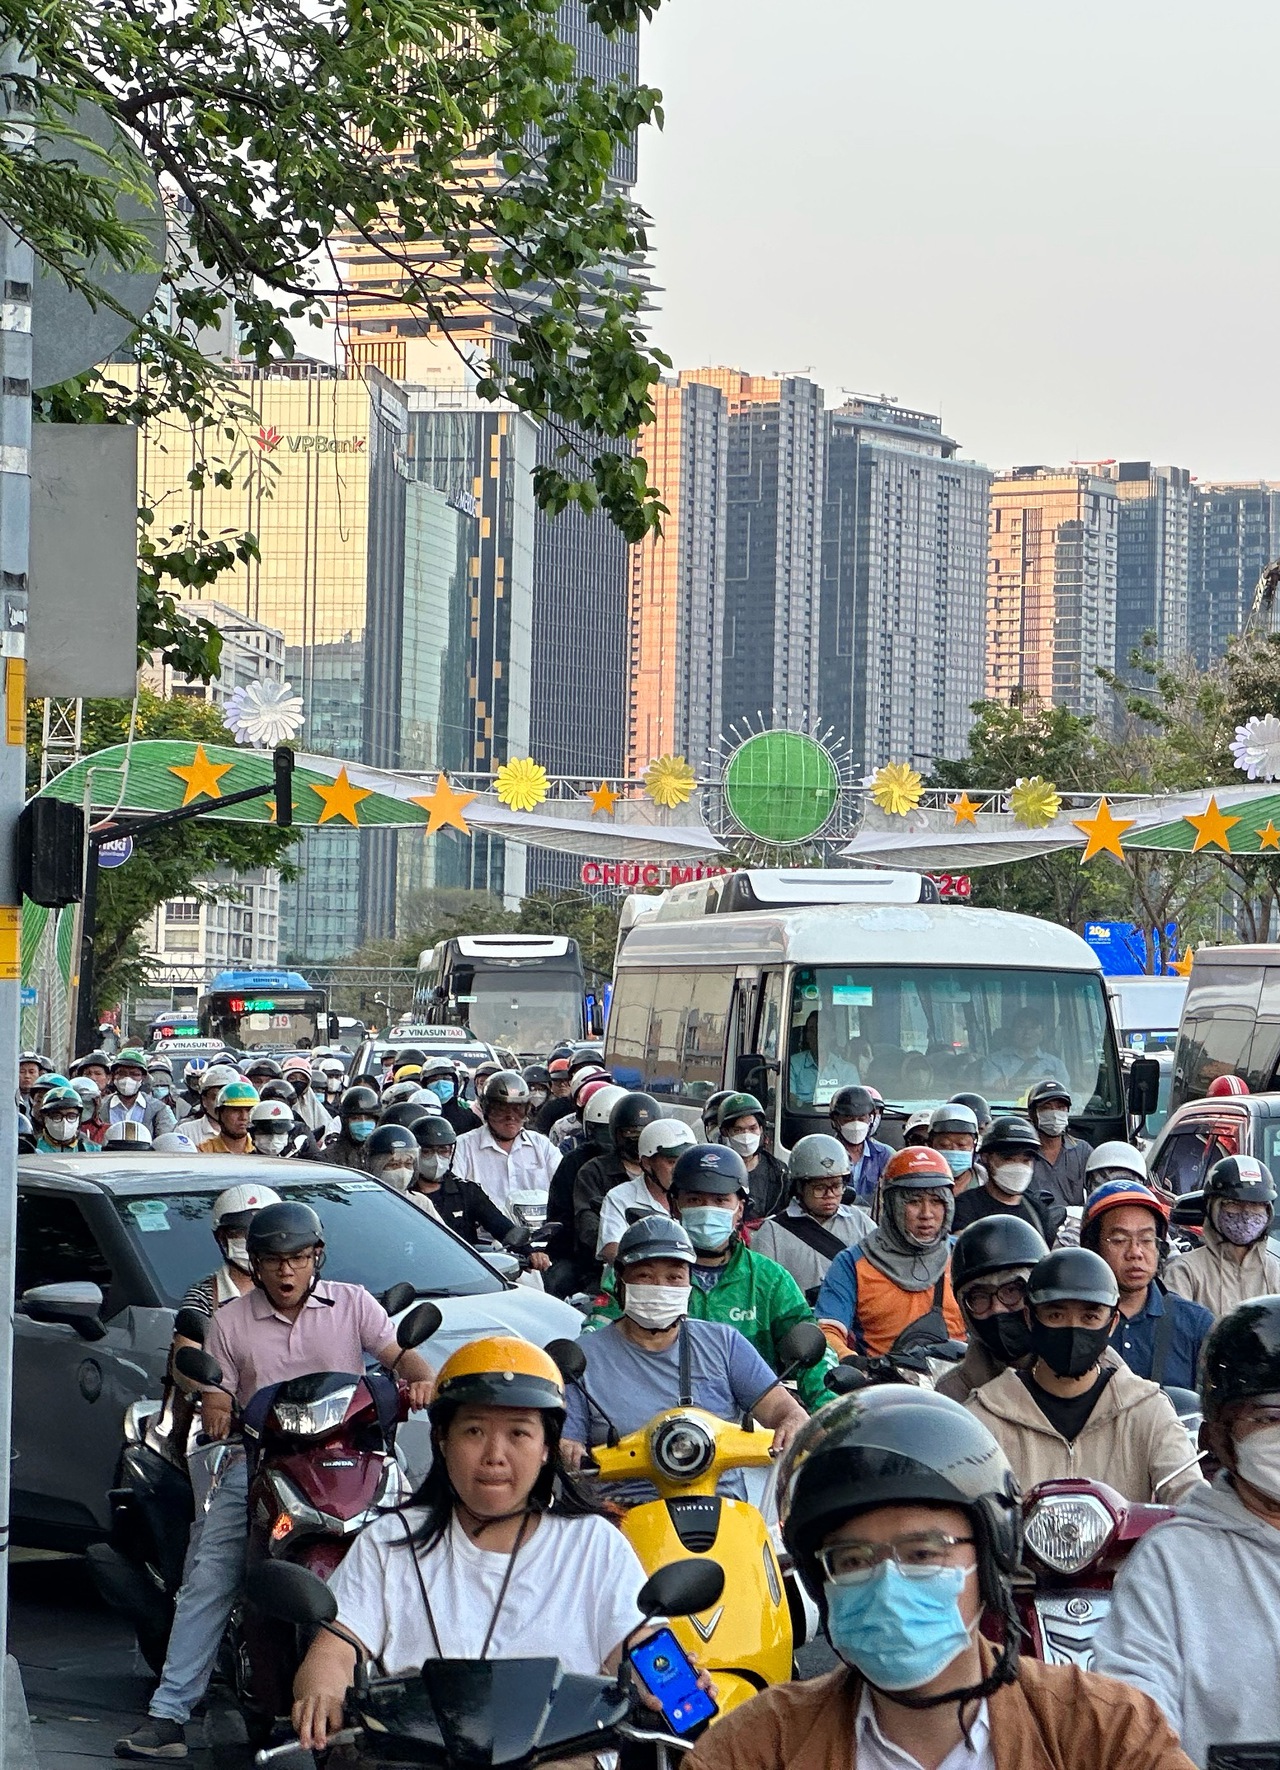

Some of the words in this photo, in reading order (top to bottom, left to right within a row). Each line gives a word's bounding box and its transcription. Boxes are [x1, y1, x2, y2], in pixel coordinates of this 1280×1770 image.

[286, 435, 366, 453] VPBank
[925, 872, 971, 897] 26
[275, 1016, 288, 1027] 19
